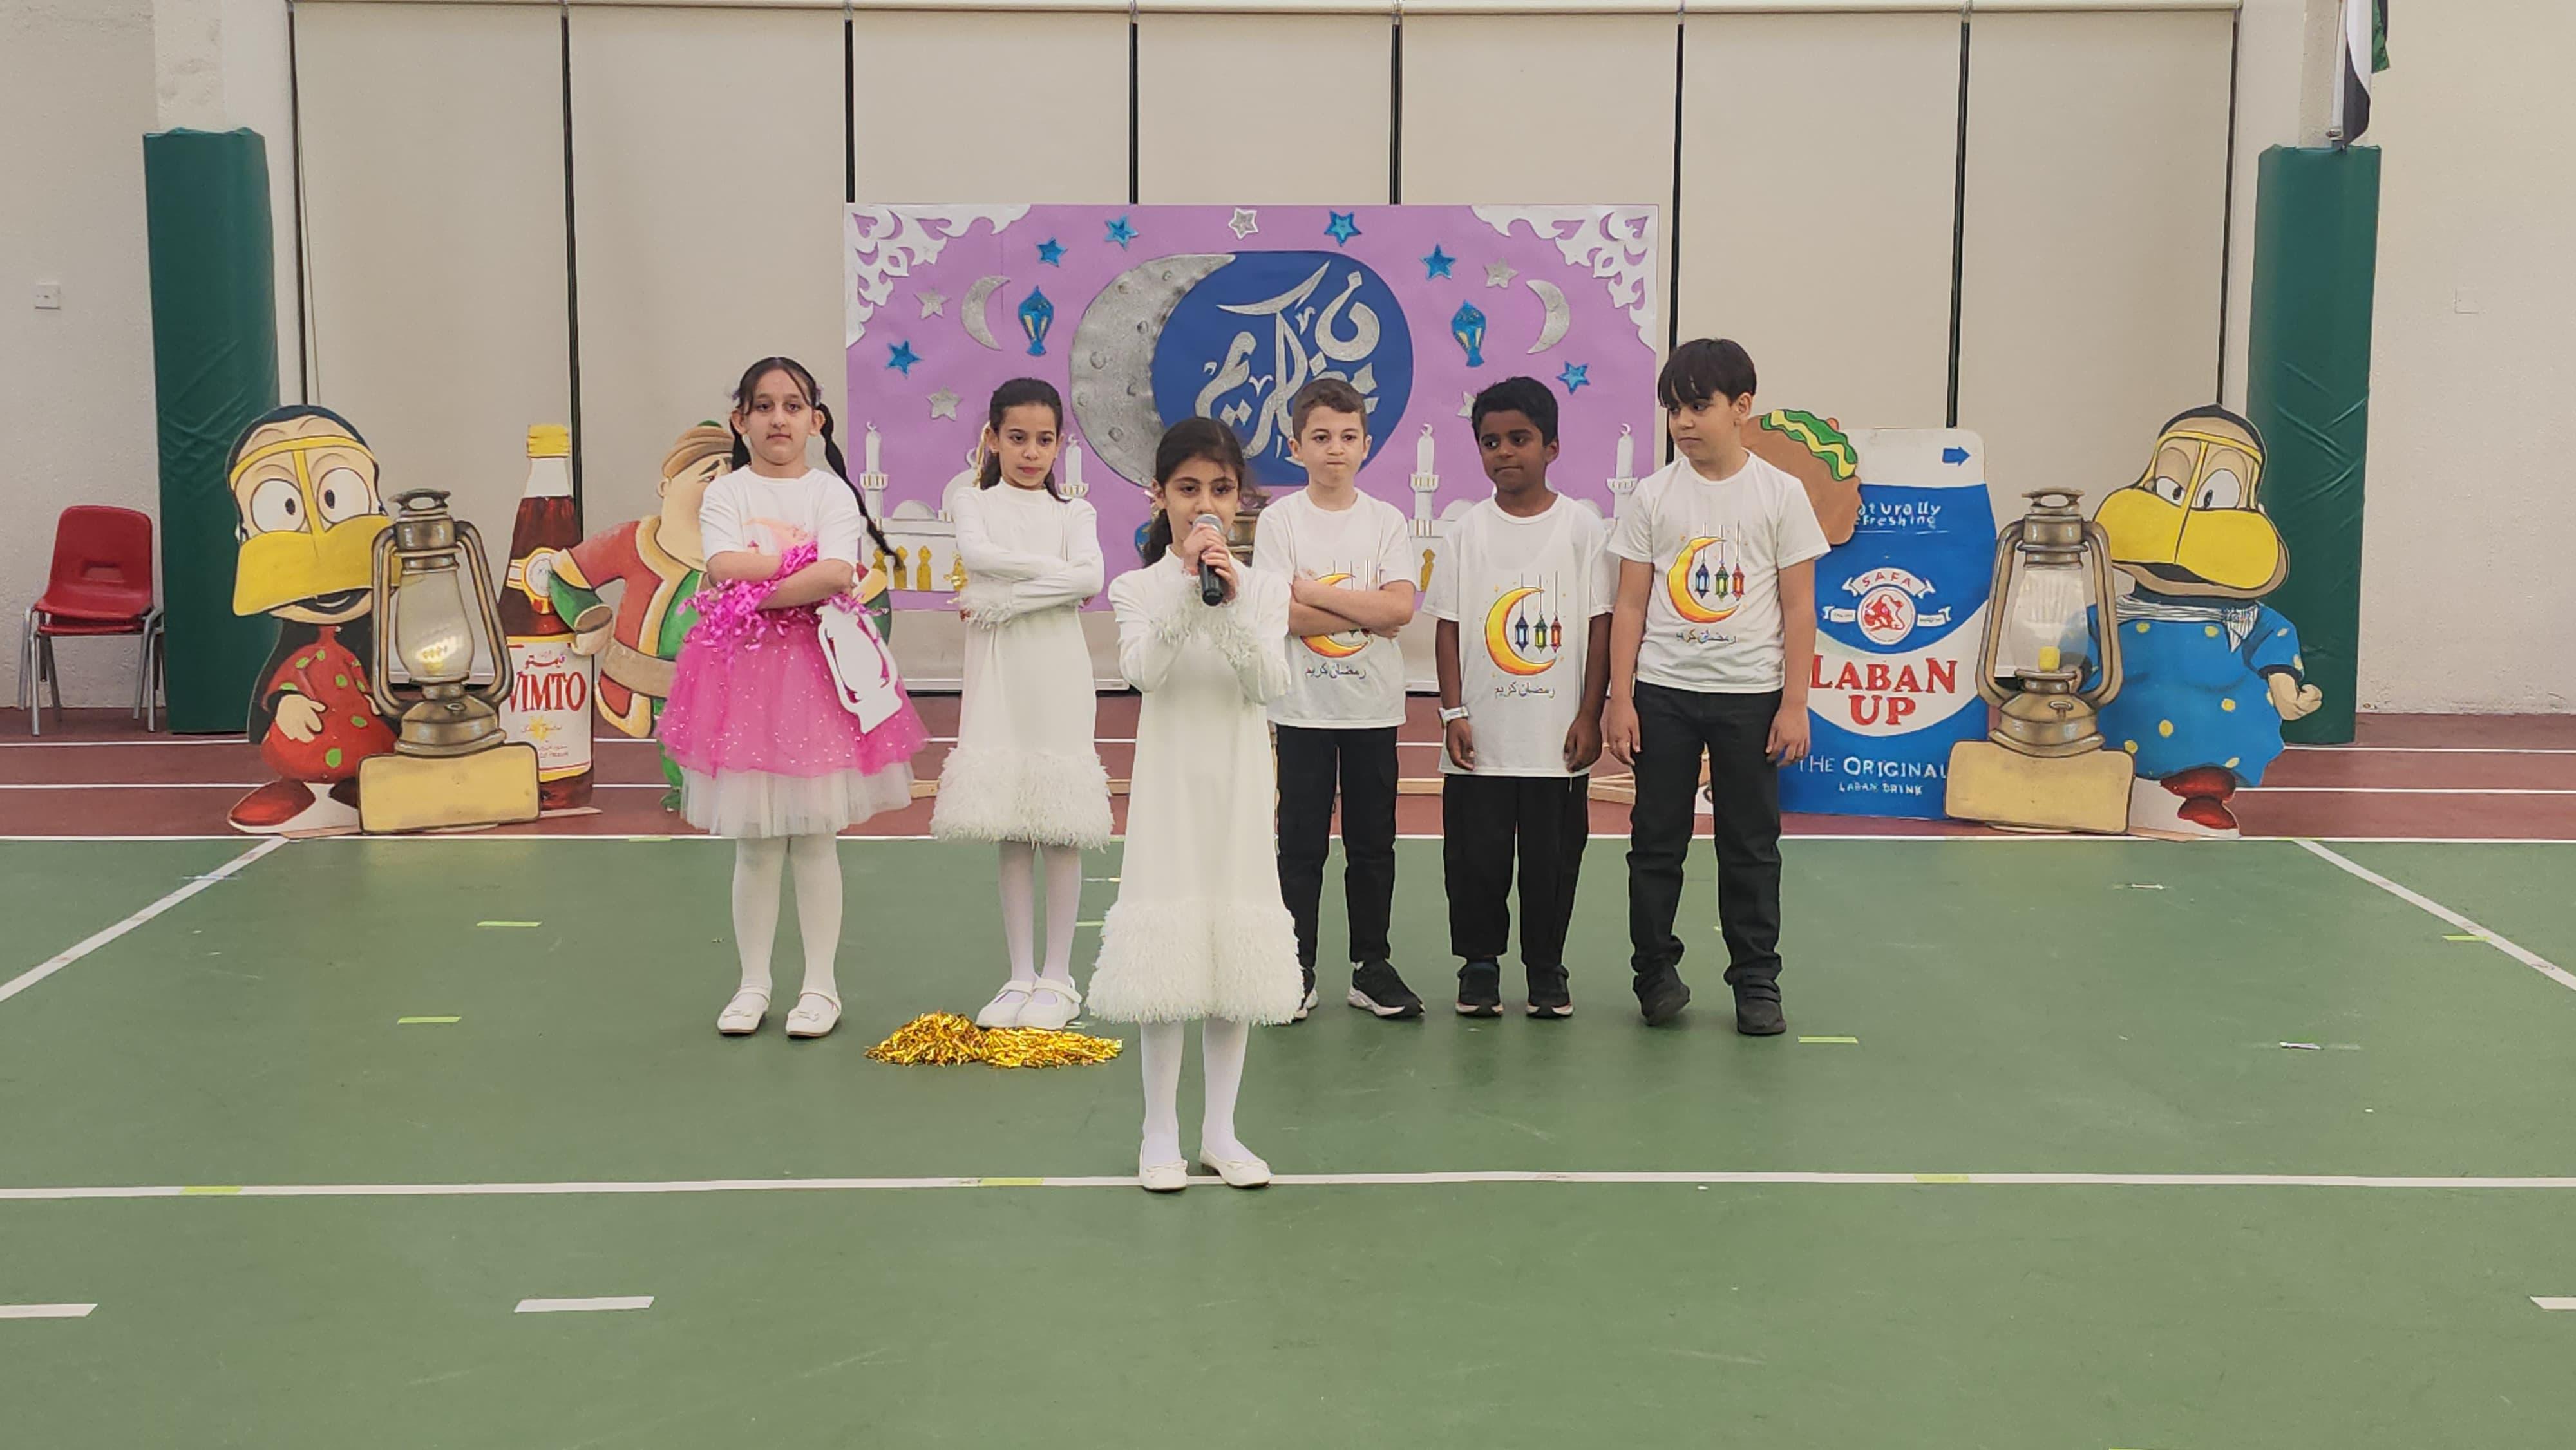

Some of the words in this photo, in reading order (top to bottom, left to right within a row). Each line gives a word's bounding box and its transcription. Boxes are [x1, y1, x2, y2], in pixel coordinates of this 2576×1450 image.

[1858, 501, 1942, 516] aturally
[1855, 514, 1937, 529] freshing
[1862, 571, 1911, 588] SAFA
[1305, 661, 1328, 680] كريم
[1329, 663, 1367, 679] رمضان
[1810, 654, 1958, 693] LABAN
[1495, 681, 1517, 699] كريم
[1518, 682, 1555, 699] رمضان
[1848, 694, 1916, 726] UP
[1843, 756, 1946, 779] ORIGINAL
[1839, 782, 1878, 793] LABAN
[1882, 781, 1923, 796] DRINK
